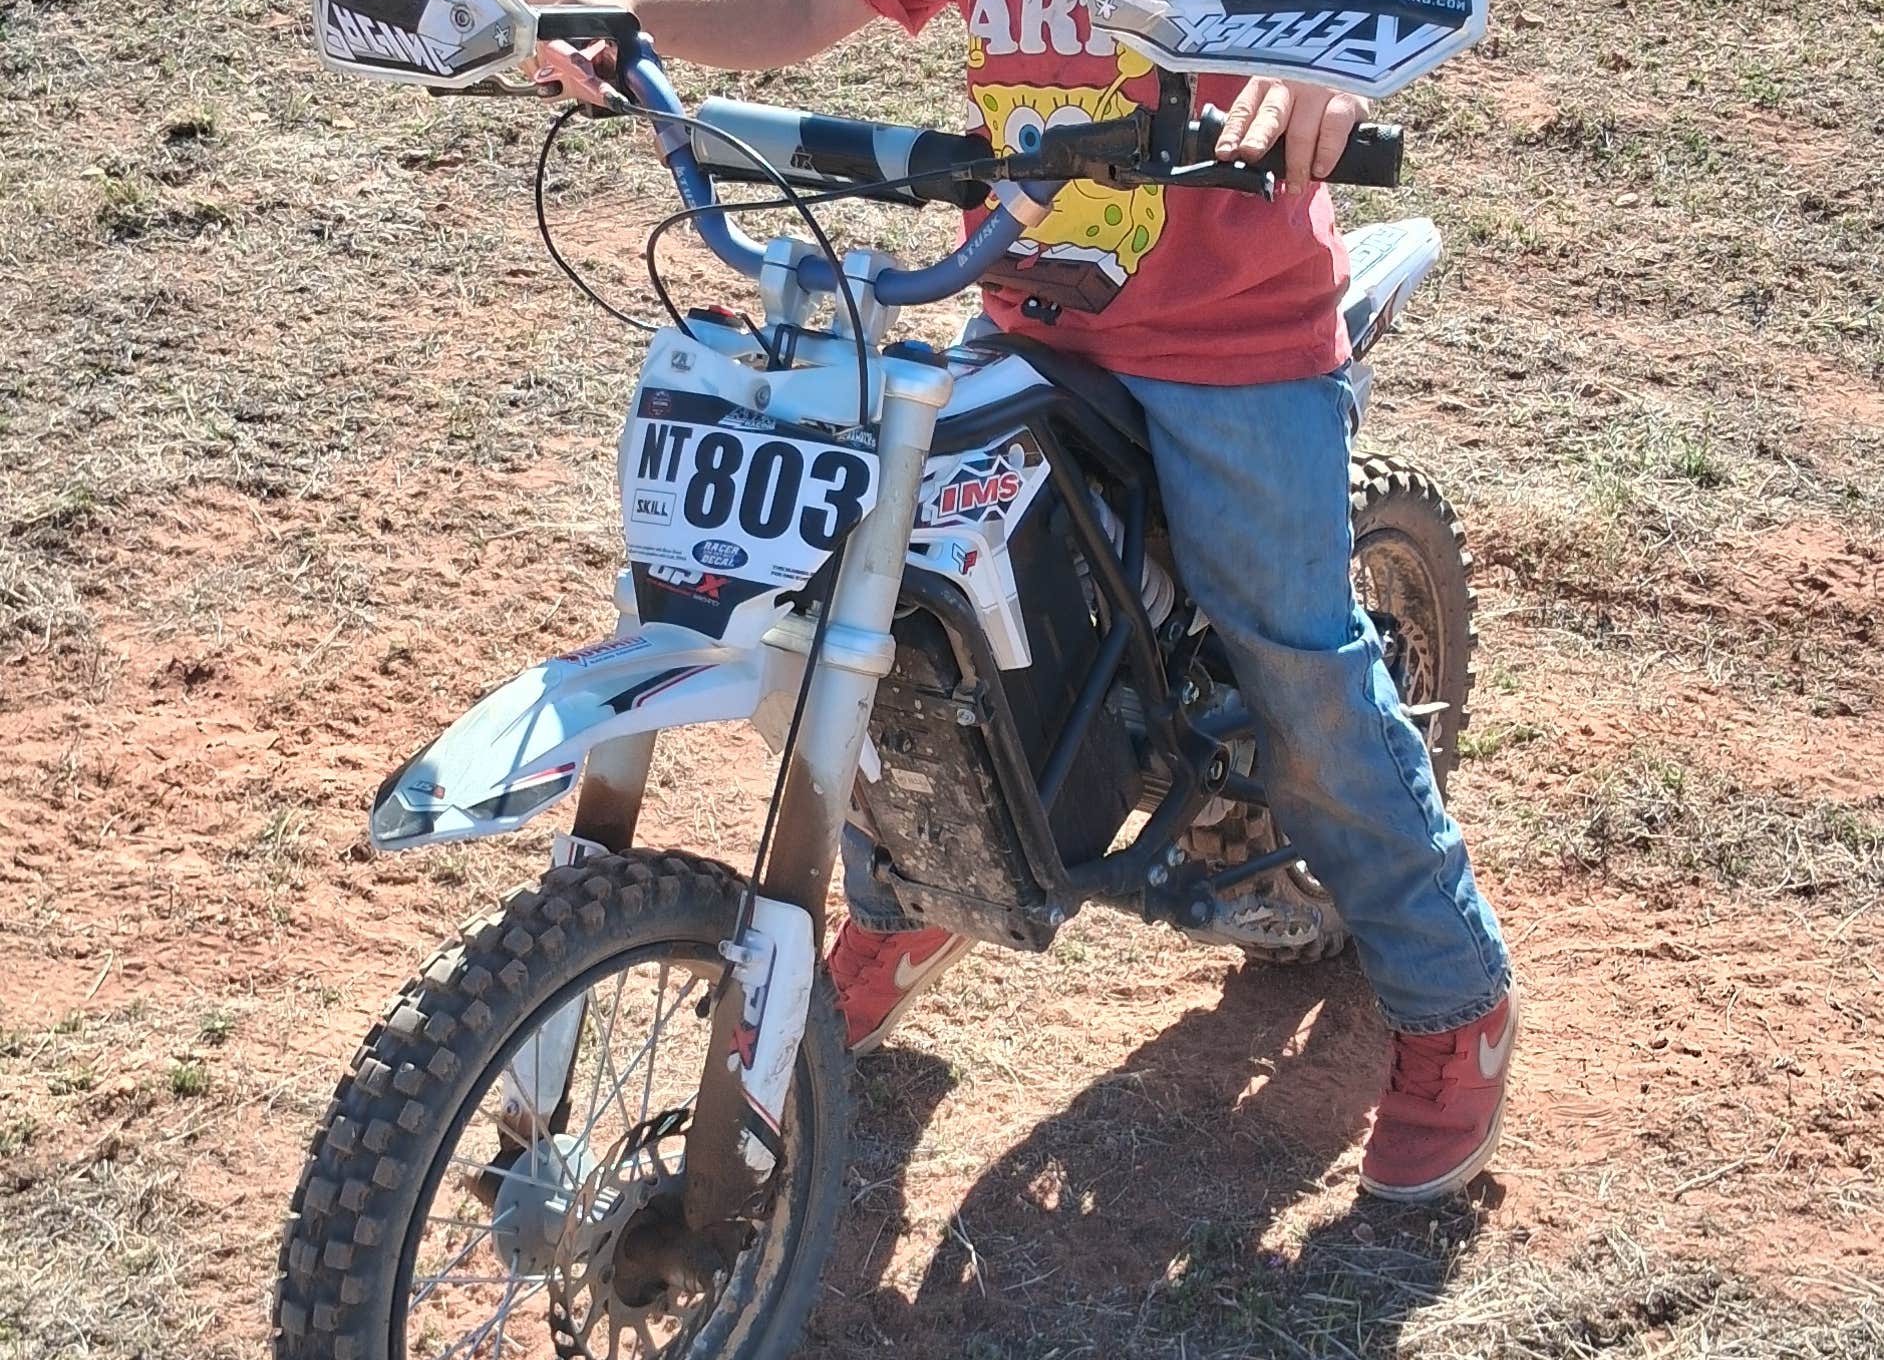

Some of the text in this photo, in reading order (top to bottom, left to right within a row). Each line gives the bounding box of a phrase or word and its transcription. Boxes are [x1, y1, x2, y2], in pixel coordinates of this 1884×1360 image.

[637, 423, 871, 552] NT 803
[637, 498, 669, 517] SKILL
[939, 471, 1020, 517] IMS
